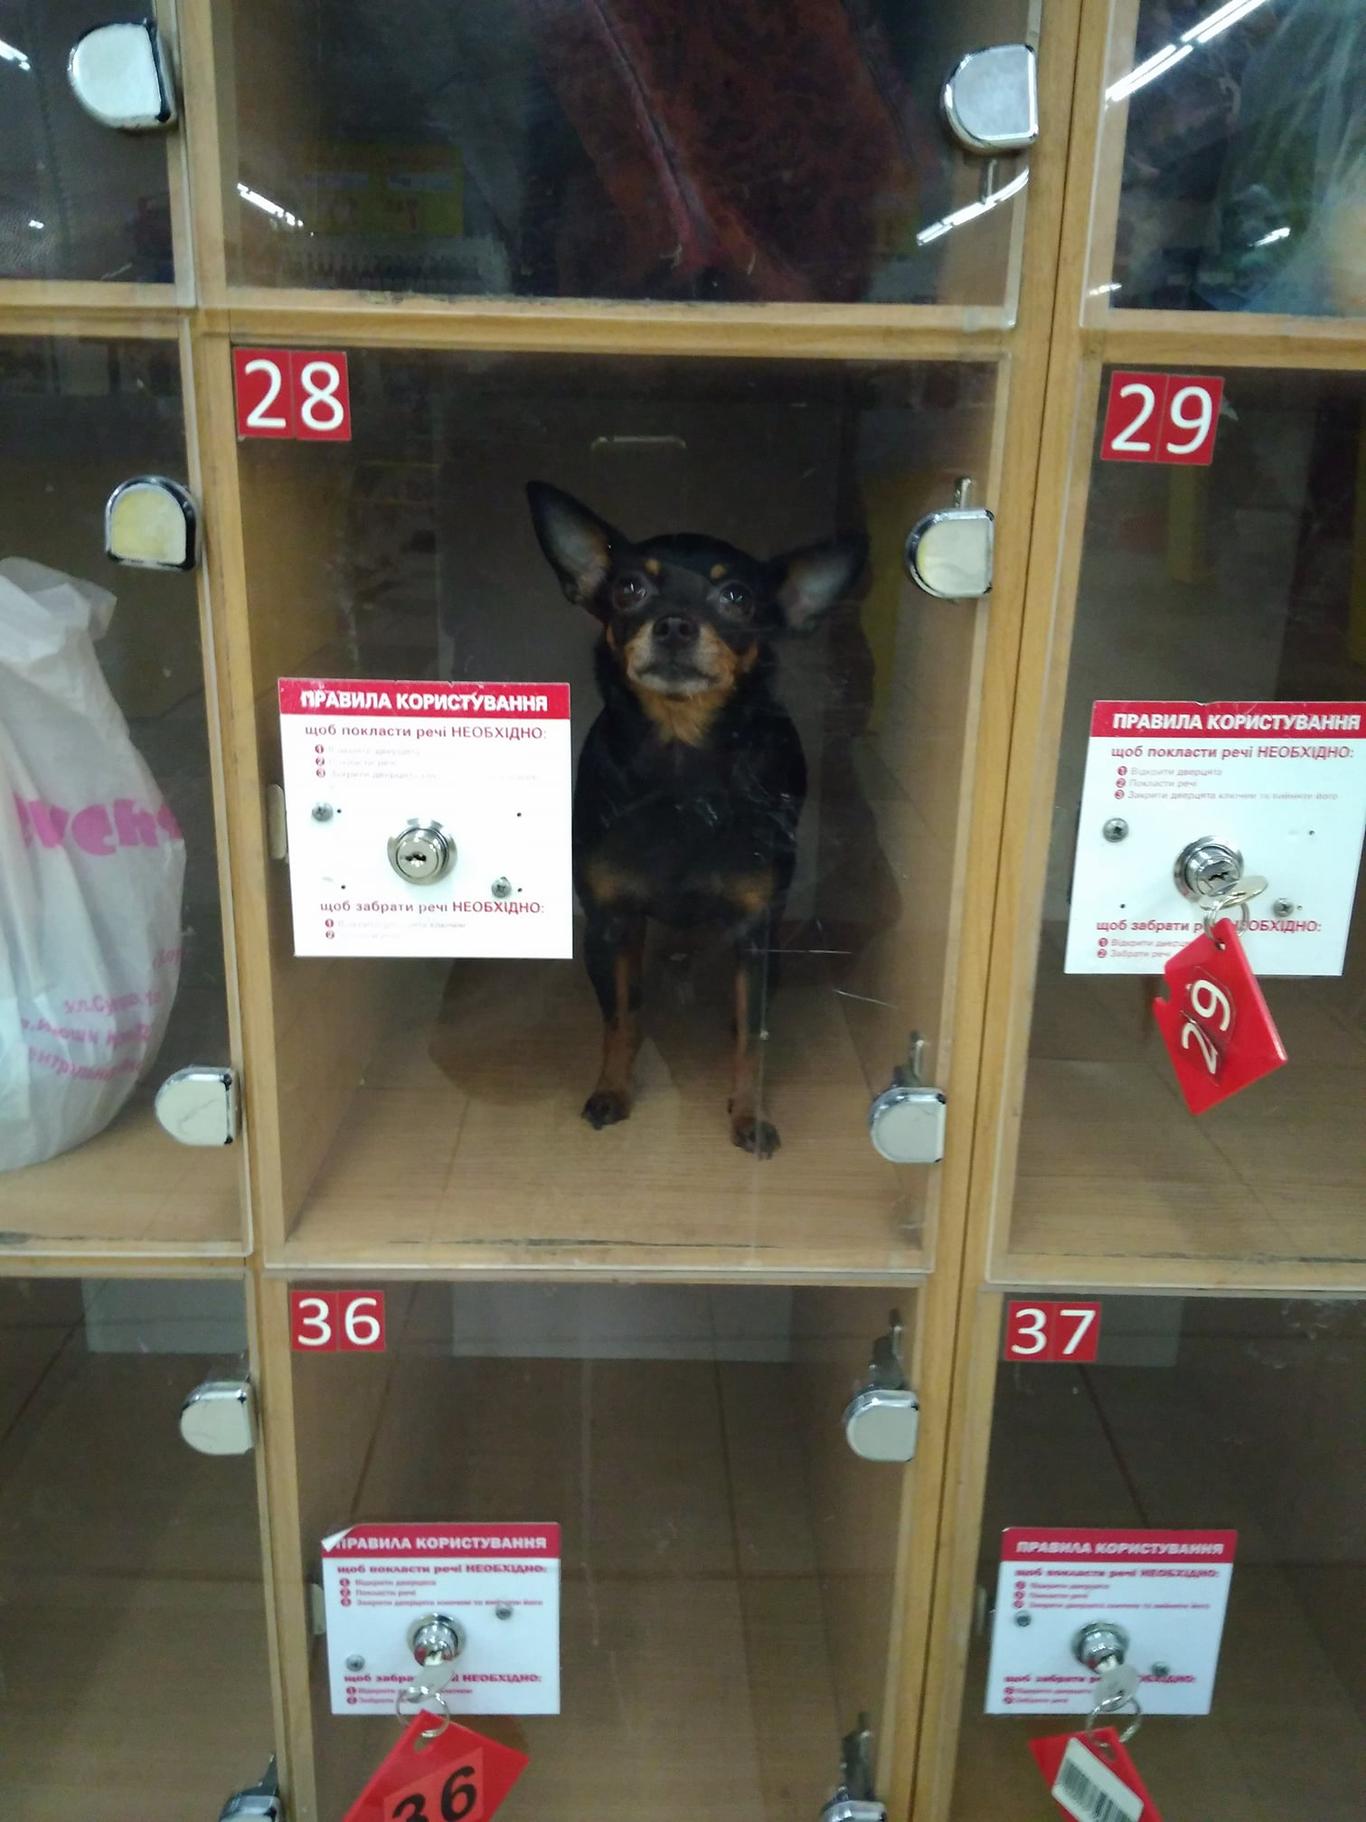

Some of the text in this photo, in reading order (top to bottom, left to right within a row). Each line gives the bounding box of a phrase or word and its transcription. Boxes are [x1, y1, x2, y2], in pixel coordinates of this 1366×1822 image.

[244, 359, 344, 432] 28
[1111, 383, 1213, 455] 29
[301, 689, 548, 712] ПРАВИЛА КОРИСТУВАННЯ
[1113, 713, 1361, 730] ПРАВИЛА КОРИСТУВАННЯ
[305, 723, 547, 741] щоб покласти речі НЕОБХІДНО:
[1111, 744, 1355, 761] щоб покласти речі НЕОБХІДНО:
[320, 900, 545, 915] щоб забрати речі НЕОБХІДНО:
[1096, 919, 1128, 933] щоб
[1131, 920, 1190, 934] забрати
[1181, 979, 1231, 1075] 29
[298, 1298, 382, 1346] 36
[1011, 1308, 1097, 1355] 37
[416, 1537, 547, 1550] КОРИСТУВАННЯ
[1016, 1541, 1224, 1556] ПРАВИЛА КОРИСТУВАННЯ
[337, 1564, 366, 1575] щоб
[465, 1564, 548, 1575] НЕОБХІДНО:
